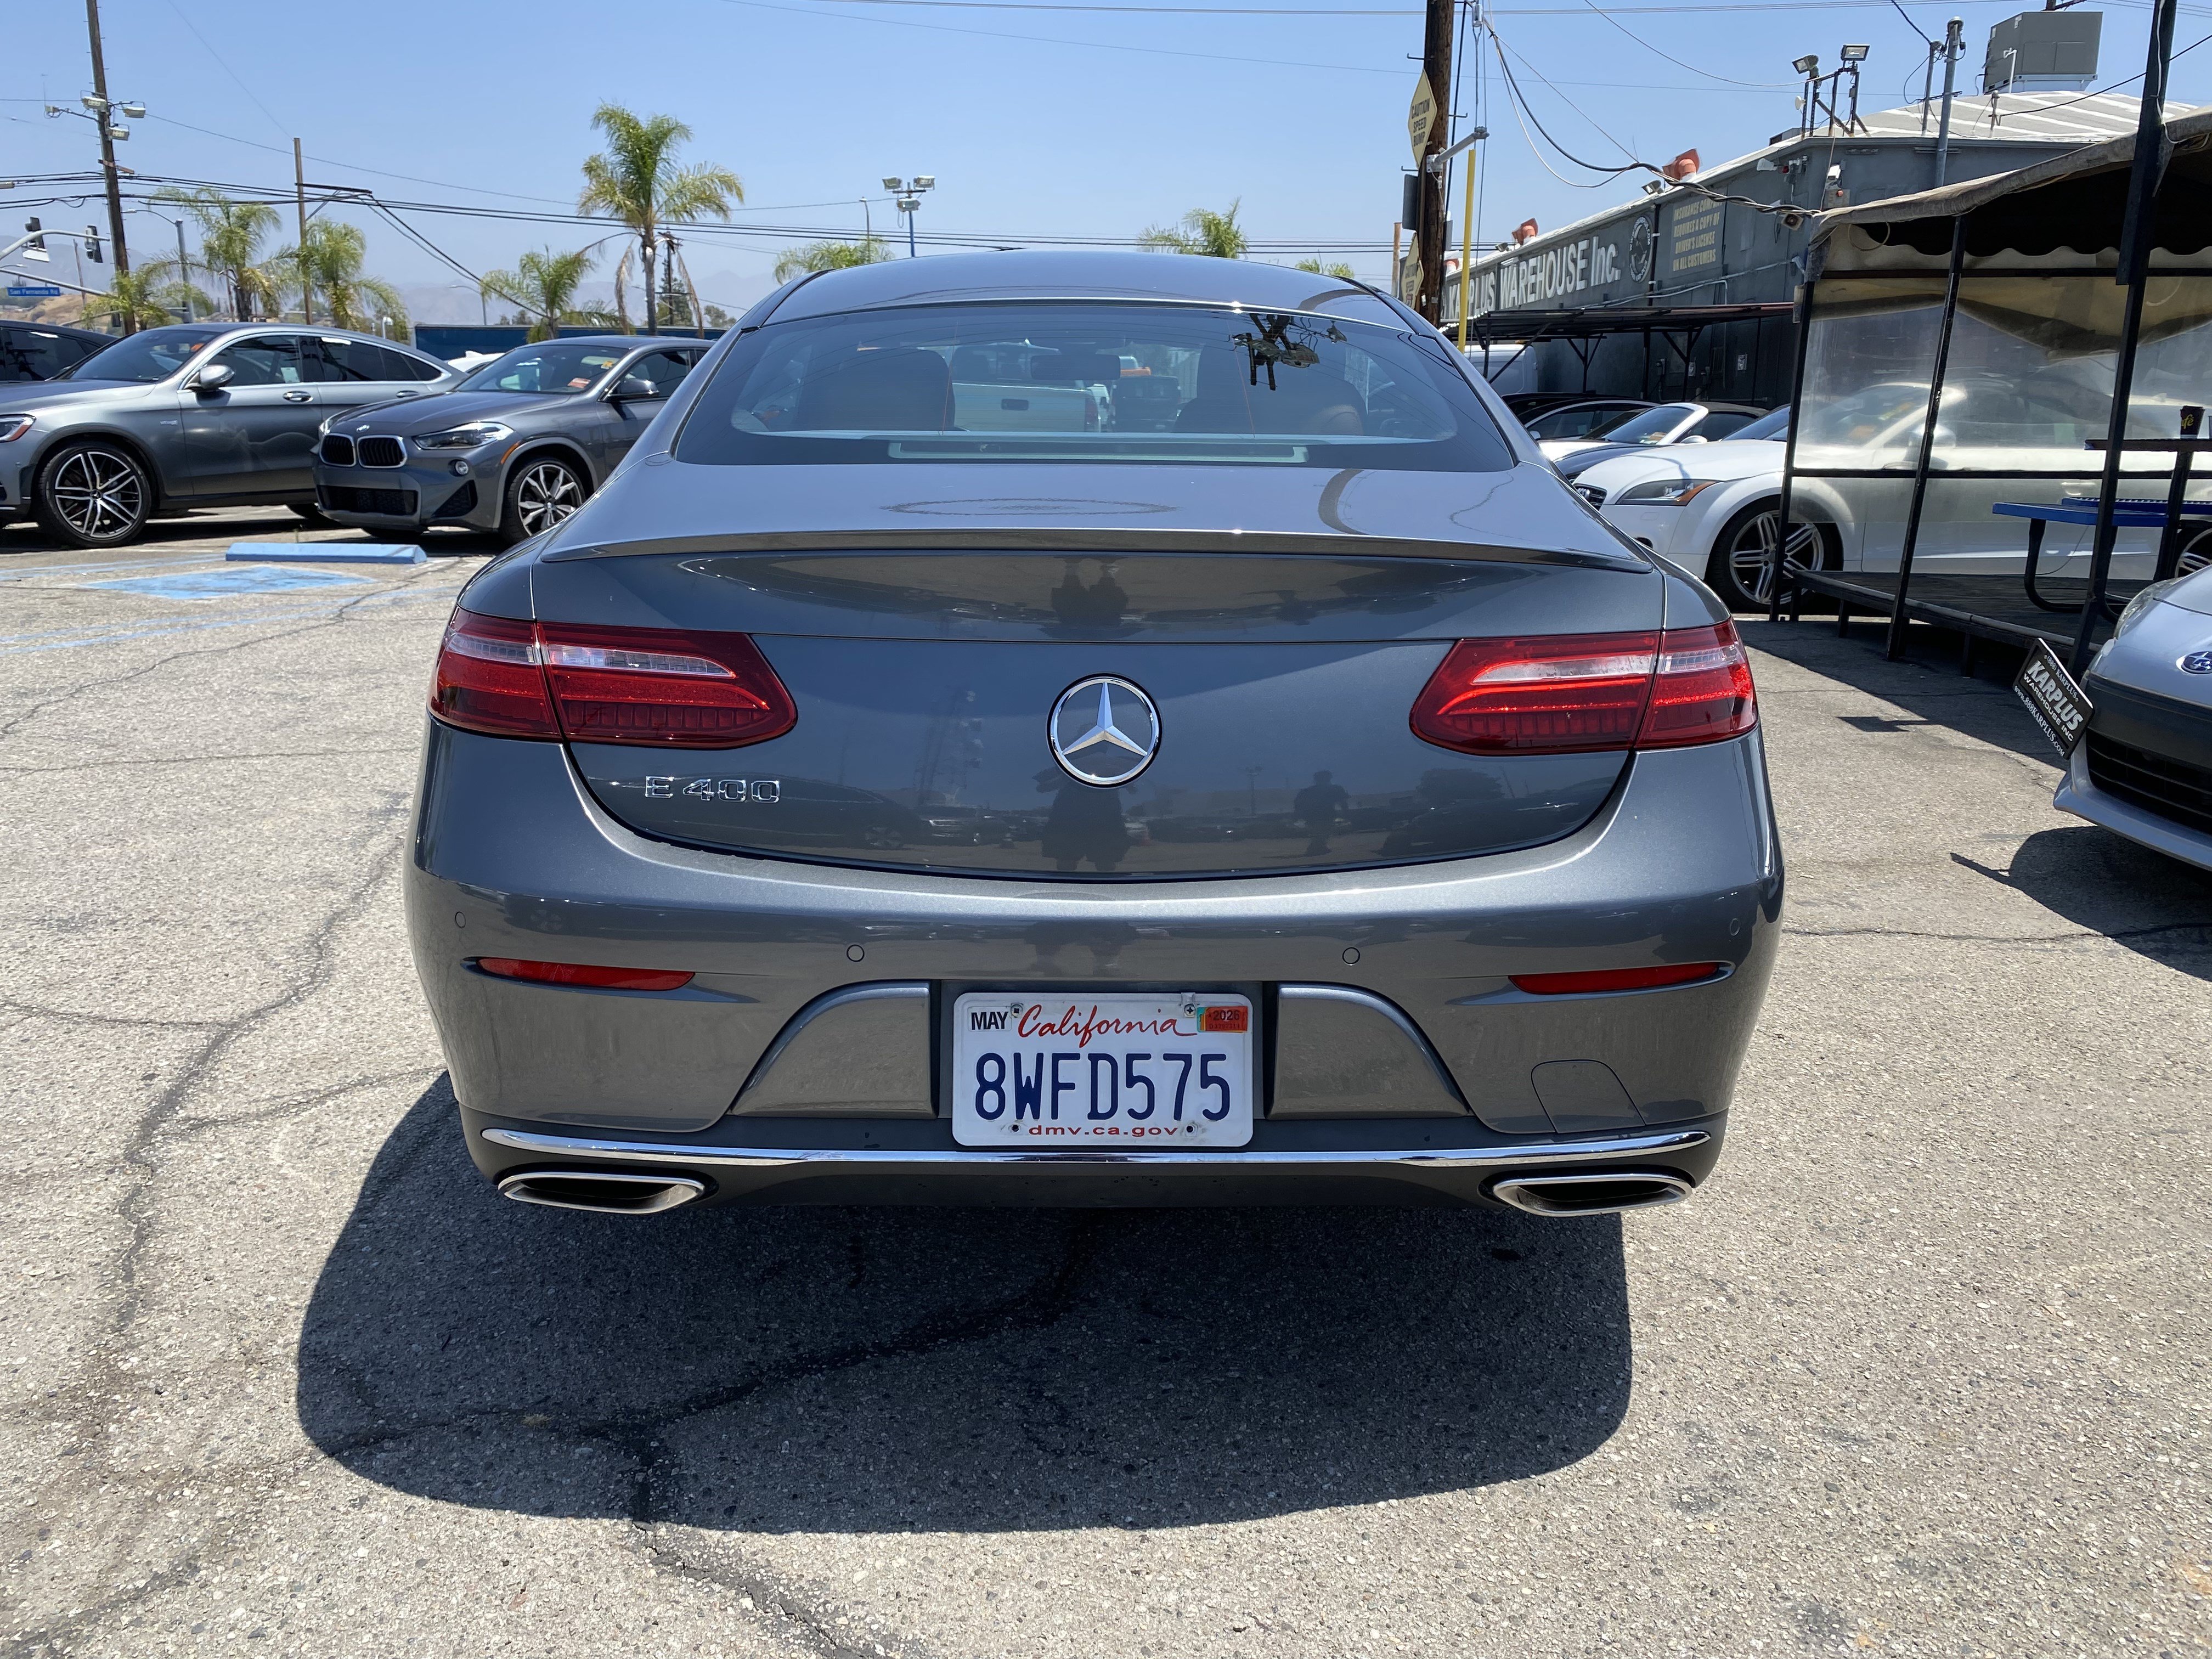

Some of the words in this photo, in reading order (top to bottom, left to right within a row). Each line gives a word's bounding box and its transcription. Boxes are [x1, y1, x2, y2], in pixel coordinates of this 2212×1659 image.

[1411, 98, 1430, 119] CAUTION
[1413, 117, 1426, 133] SPEED
[1413, 131, 1425, 147] BUMP
[1674, 201, 1700, 221] INSURANCE
[1700, 198, 1722, 213] COMP
[1674, 219, 1695, 238] REQUIRES
[1695, 218, 1700, 231] A
[1700, 214, 1713, 230] COPY
[1713, 212, 1720, 225] OF
[1675, 237, 1695, 254] DRIVER'S
[1695, 231, 1715, 248] LICENSE
[1673, 259, 1679, 272] ON
[1688, 249, 1716, 268] CUSTOMERS
[1449, 272, 1495, 318] KAPLUS
[1500, 239, 1589, 309] WAREHOUSE
[1592, 236, 1621, 287] Inc.
[2047, 655, 2057, 671] (888)
[2056, 669, 2078, 699] KARPLUS
[2023, 673, 2062, 726] WAREHOUSE
[2061, 725, 2074, 741] INC
[2027, 660, 2084, 731] KARPLUS
[645, 776, 674, 798] E
[682, 778, 780, 803] 400
[971, 1011, 1009, 1030] MAY
[1017, 1004, 1198, 1048] California
[1213, 1009, 1240, 1020] 2026
[975, 1052, 1230, 1121] 8WFD575
[1028, 1125, 1178, 1137] dmv.ca.gov
